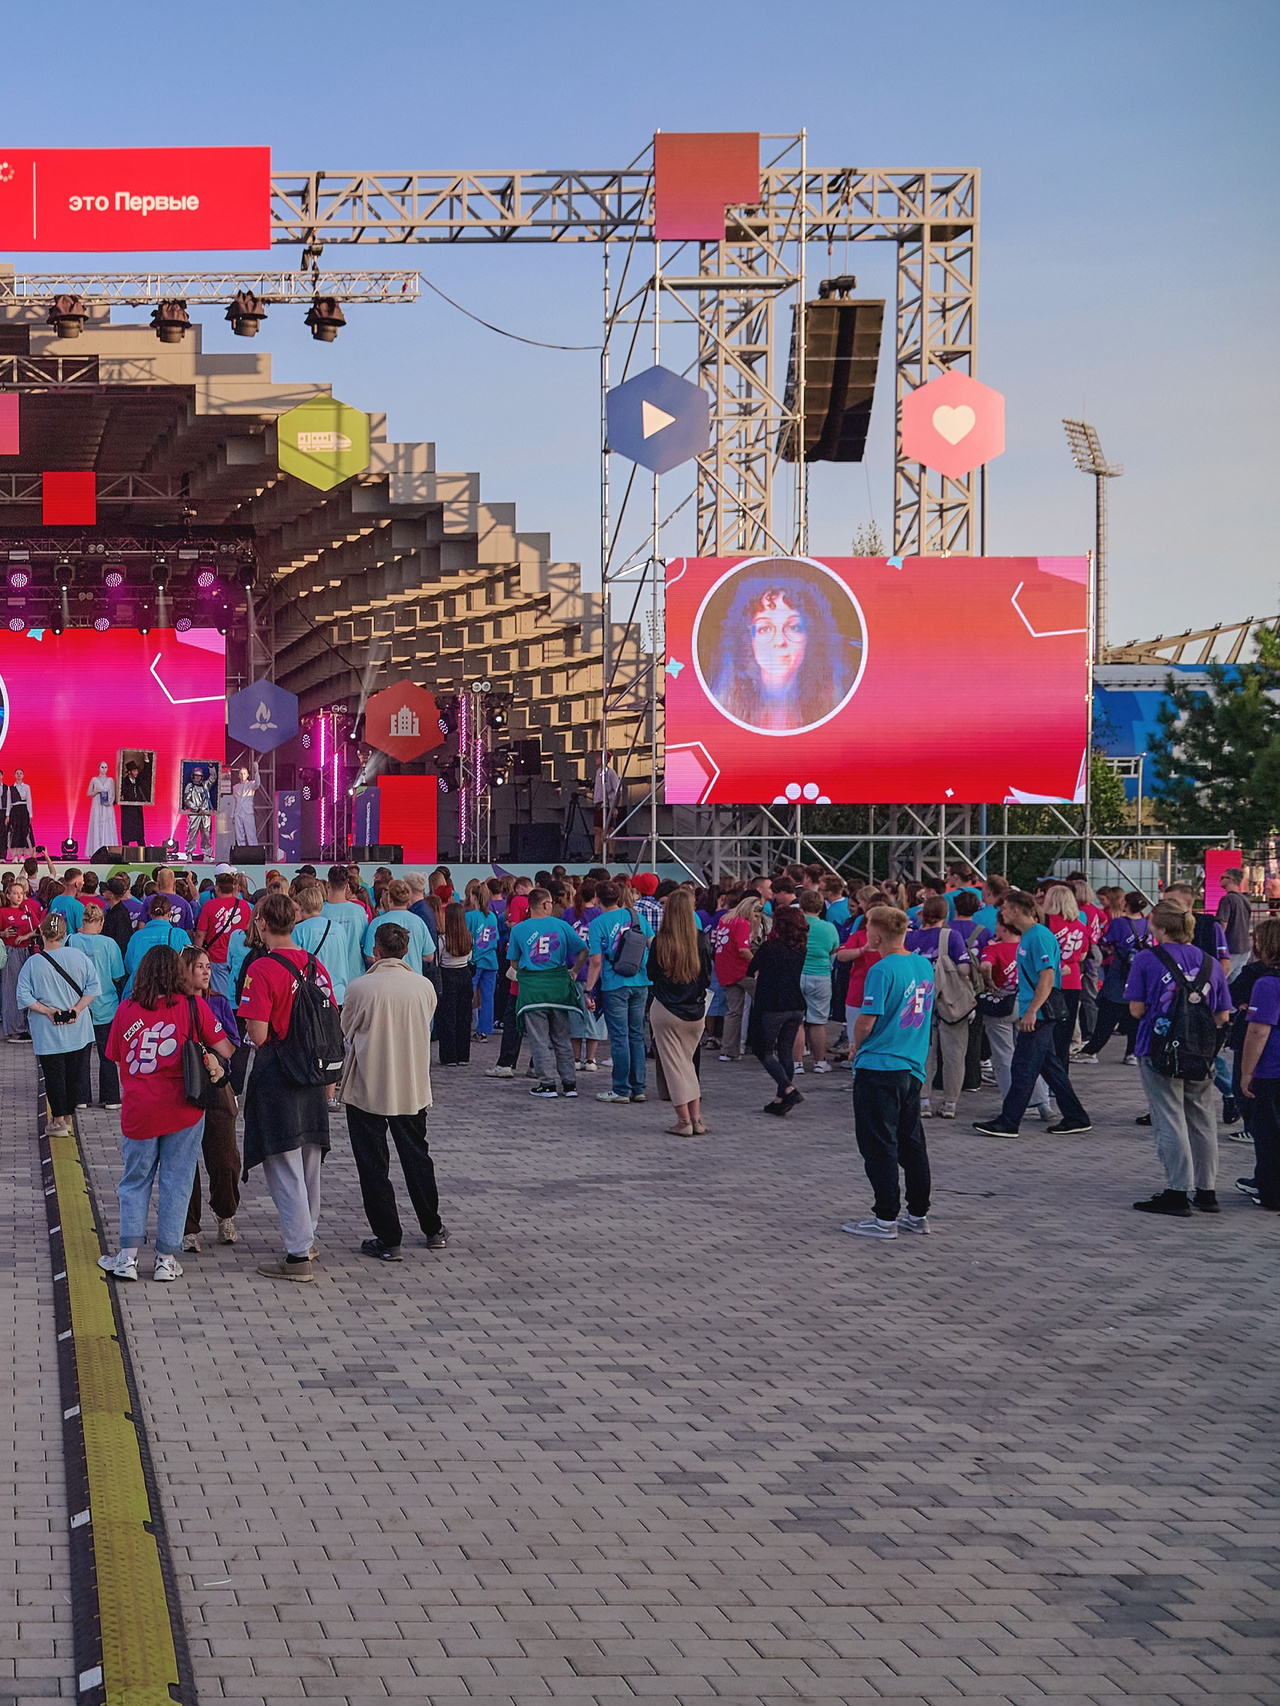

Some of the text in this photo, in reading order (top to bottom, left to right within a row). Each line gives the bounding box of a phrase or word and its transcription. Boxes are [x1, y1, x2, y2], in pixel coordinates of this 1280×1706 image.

[68, 191, 200, 217] это Первые
[483, 928, 490, 942] 5
[538, 936, 549, 954] 5
[914, 988, 926, 1013] 5
[123, 1018, 144, 1041] СЕЗОН
[140, 1031, 160, 1060] 5
